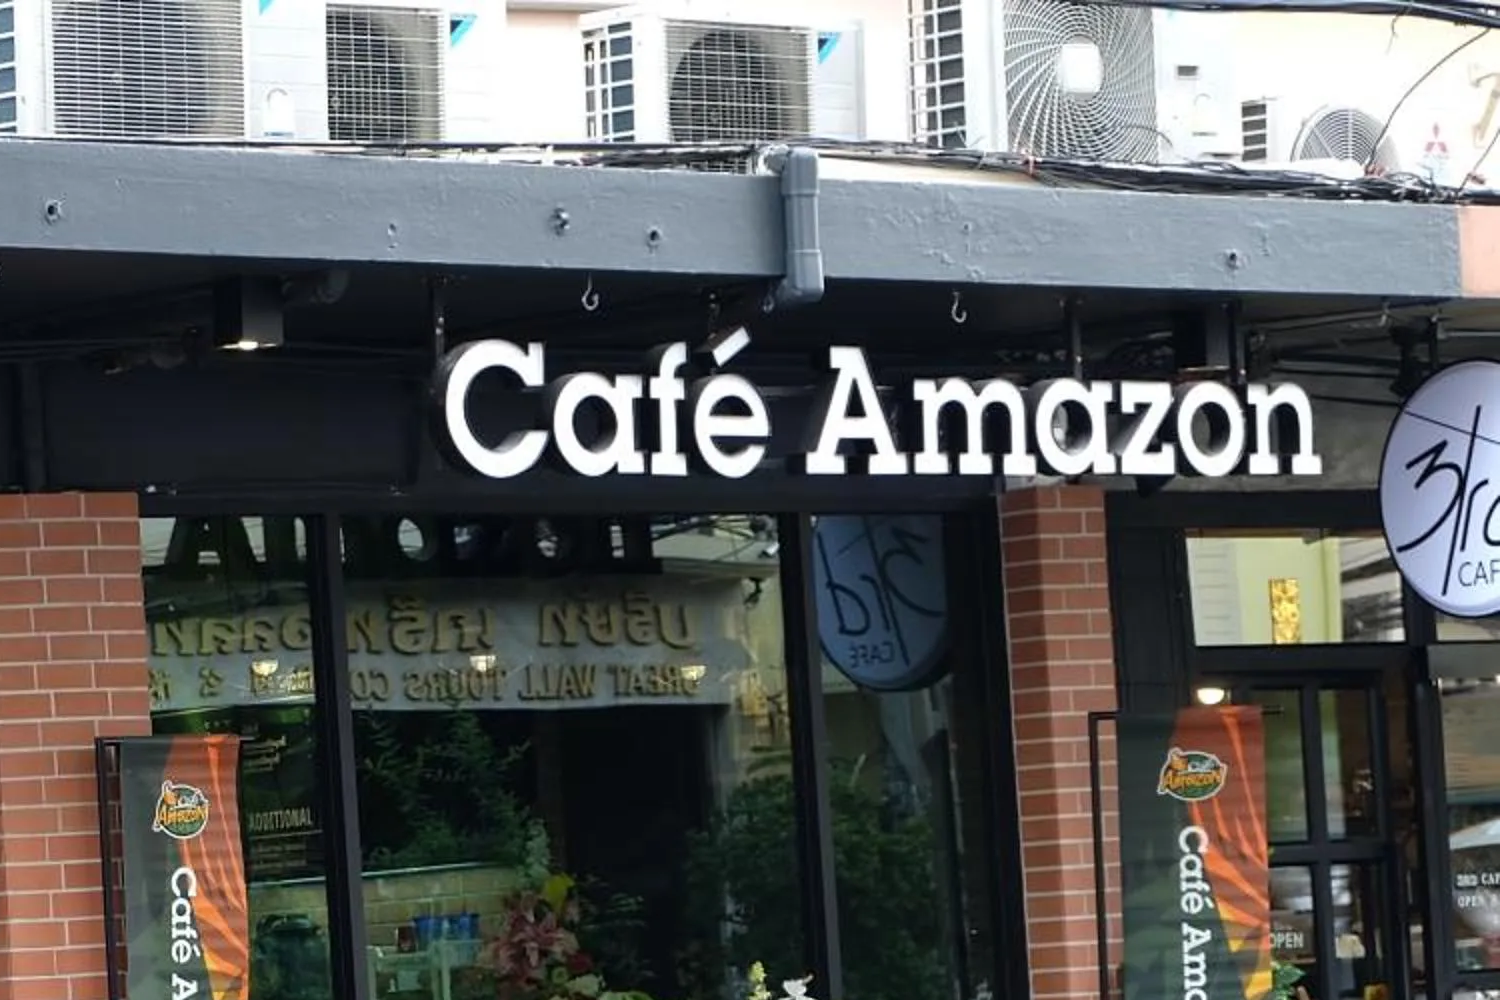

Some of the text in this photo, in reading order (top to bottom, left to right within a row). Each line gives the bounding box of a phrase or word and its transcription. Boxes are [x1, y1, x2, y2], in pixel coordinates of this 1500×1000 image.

[445, 327, 1321, 478] Café Amazon
[171, 866, 201, 963] Café
[1179, 825, 1214, 914] Café
[1268, 931, 1304, 949] OPEN
